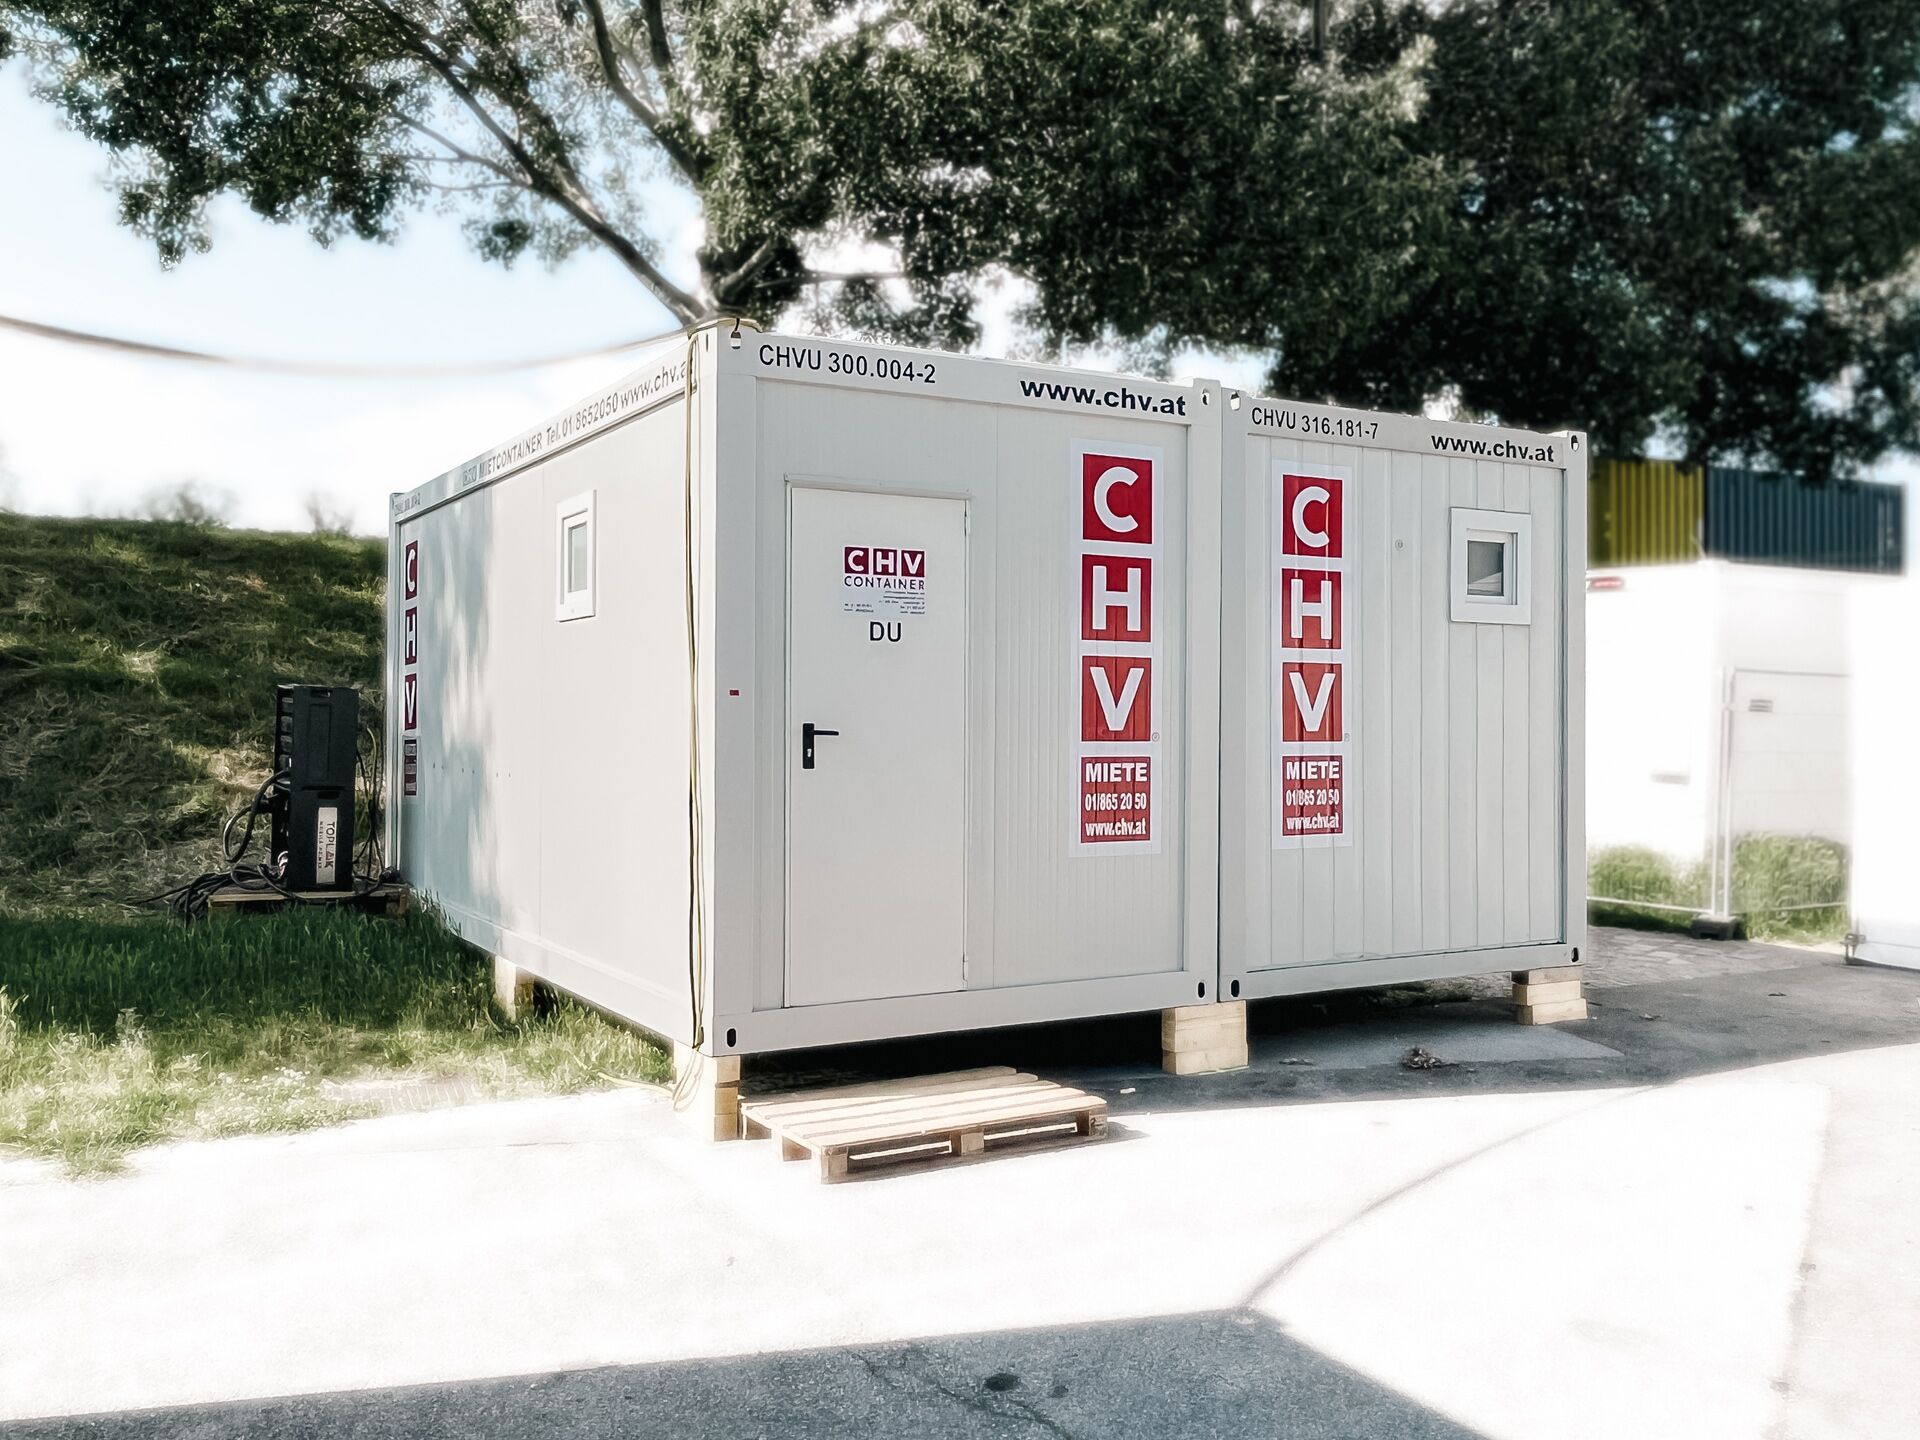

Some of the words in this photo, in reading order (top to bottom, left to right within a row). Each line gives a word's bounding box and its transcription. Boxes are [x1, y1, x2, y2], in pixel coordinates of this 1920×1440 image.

[759, 344, 821, 370] CHVU
[828, 351, 936, 384] 300.004-2
[620, 361, 687, 410] www.chv.a
[1020, 379, 1186, 416] www.chv.at
[1252, 406, 1296, 430] CHVU
[1301, 415, 1379, 440] 316.181-7
[1431, 434, 1555, 463] www.chv.at
[846, 549, 923, 575] CHV
[844, 575, 925, 591] CONTAINER
[869, 621, 902, 642] DU
[1085, 762, 1148, 782] MIETE
[1286, 761, 1340, 780] MIETE
[1085, 792, 1118, 811] 01/865
[1120, 792, 1133, 810] 20
[1135, 792, 1147, 810] 50
[1316, 789, 1327, 806] 20
[1328, 788, 1340, 806] 50
[1085, 817, 1147, 836] www.chv.at
[1286, 812, 1340, 830] www.chv.at
